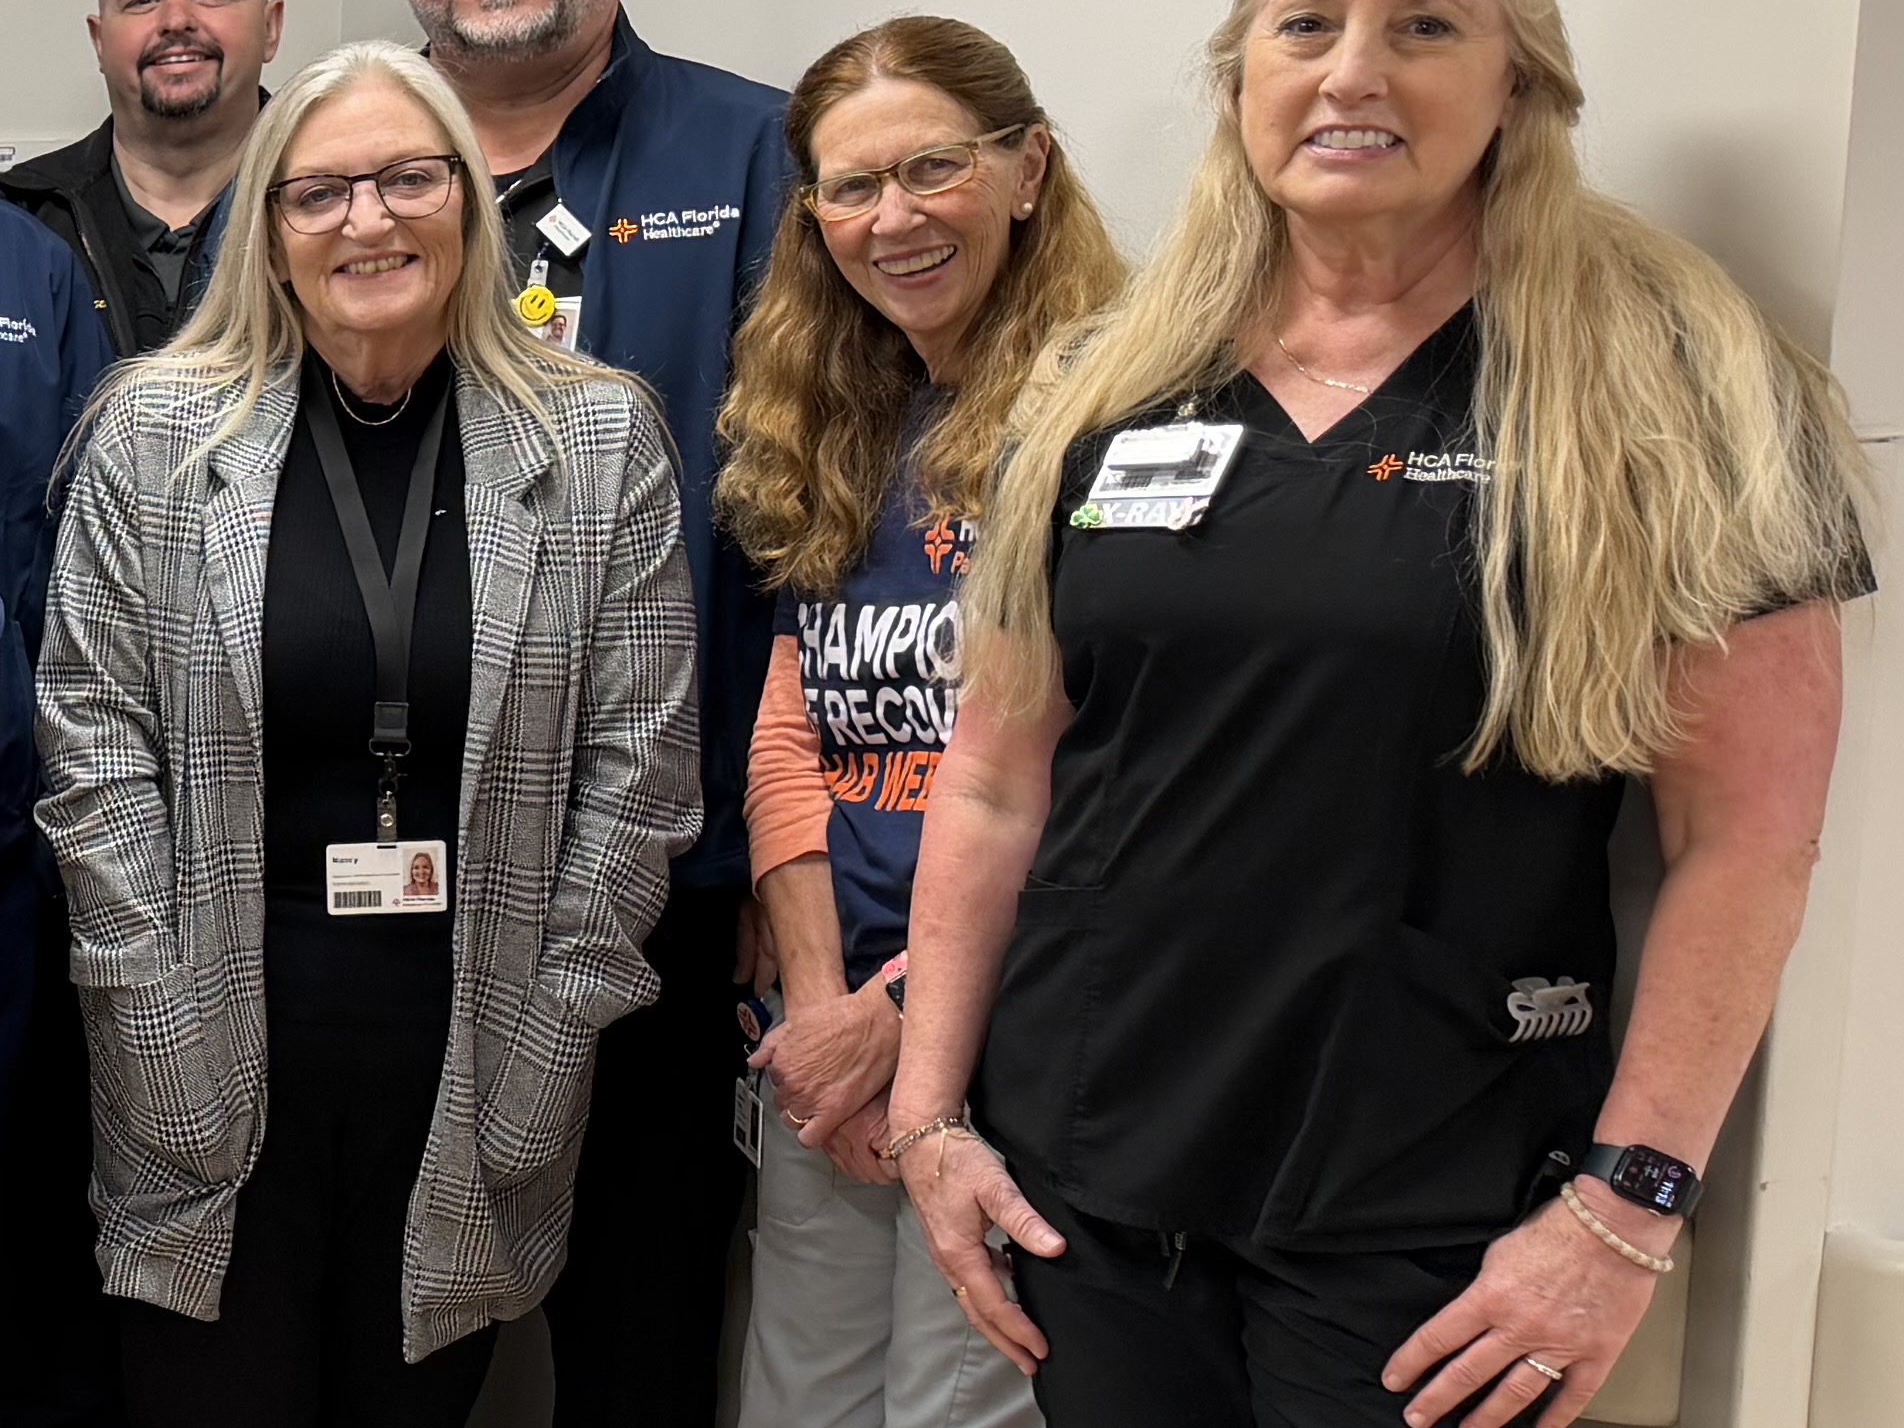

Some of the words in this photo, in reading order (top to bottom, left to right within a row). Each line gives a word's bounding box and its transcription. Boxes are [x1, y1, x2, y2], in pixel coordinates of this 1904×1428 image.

[640, 211, 679, 227] HCA
[681, 204, 740, 224] Florida
[1406, 451, 1452, 468] HCA
[1454, 453, 1496, 470] Flor
[798, 601, 963, 681] HAMPIO
